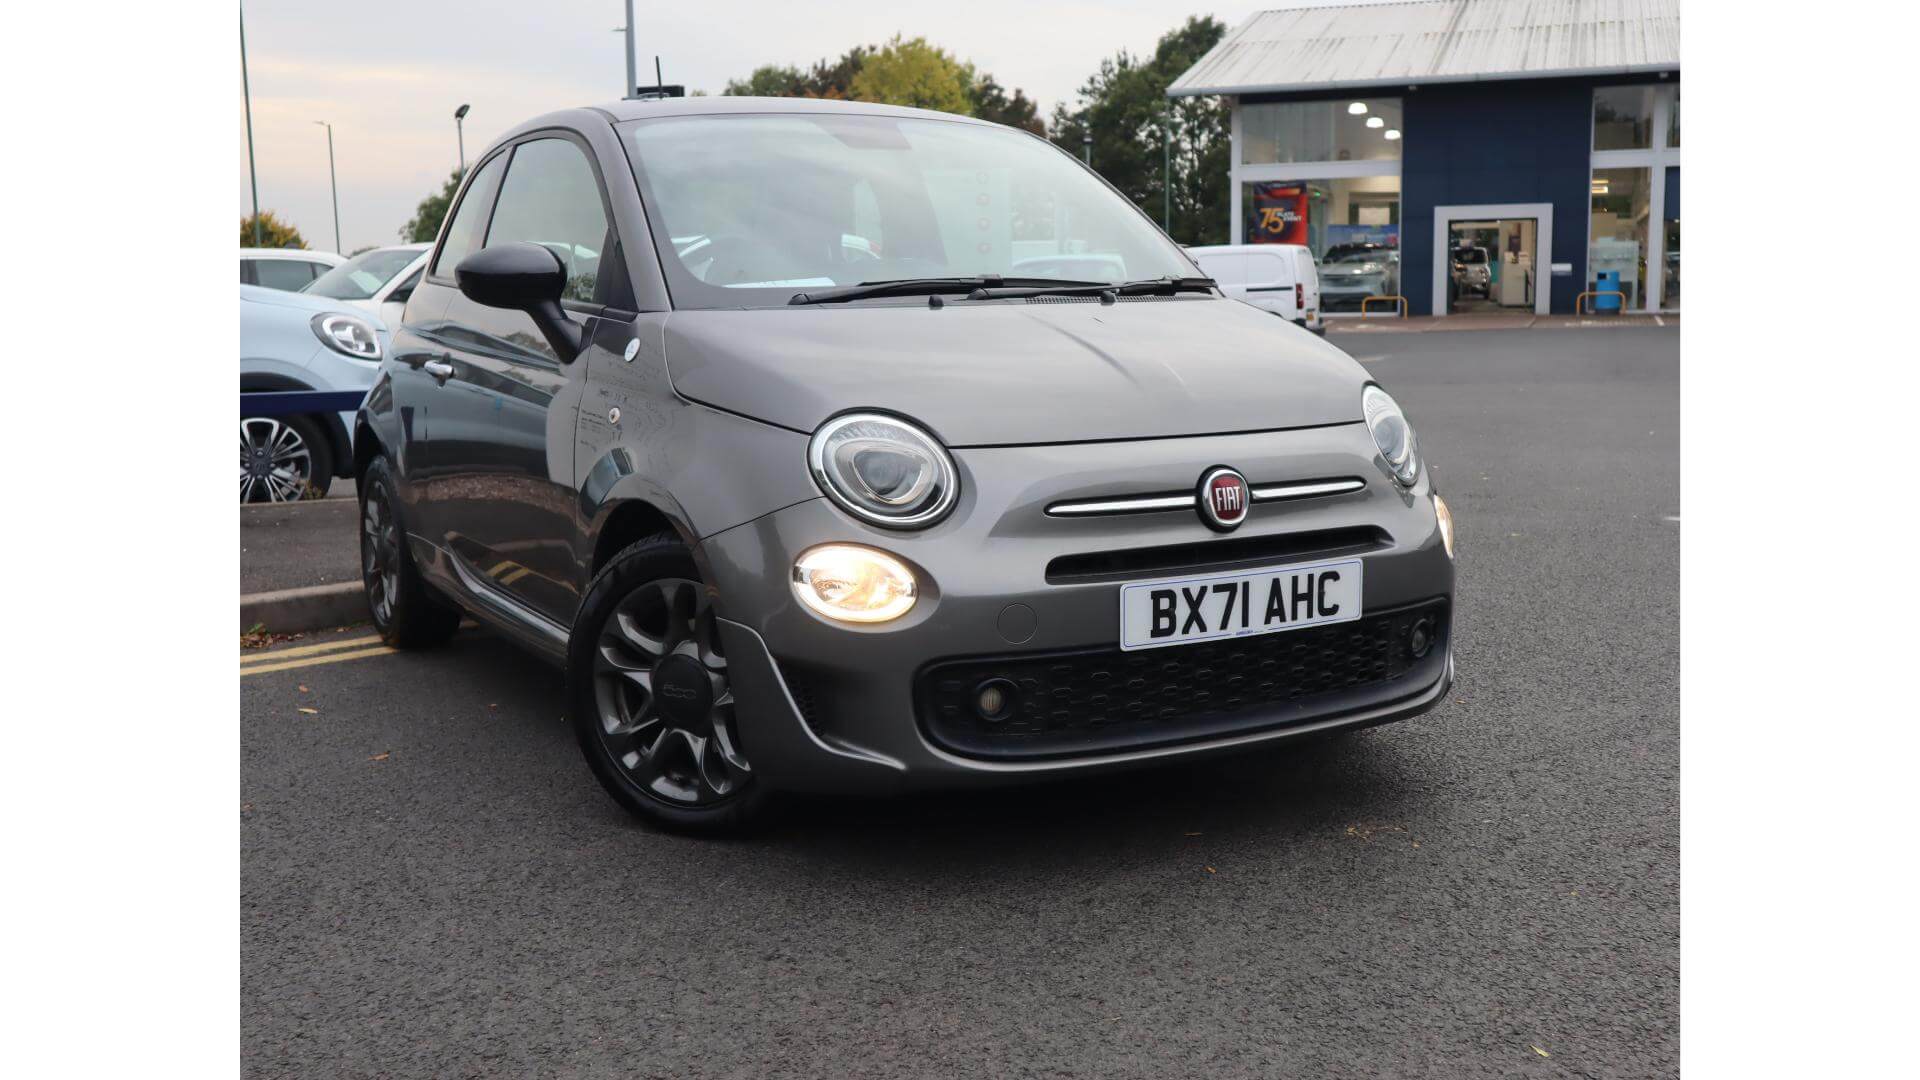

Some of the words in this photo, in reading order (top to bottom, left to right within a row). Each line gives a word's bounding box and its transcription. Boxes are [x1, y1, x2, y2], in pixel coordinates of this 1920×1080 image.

[1260, 208, 1284, 233] 75
[1215, 486, 1241, 511] FIAT
[1150, 581, 1250, 638] BX71
[1264, 570, 1340, 625] AHC
